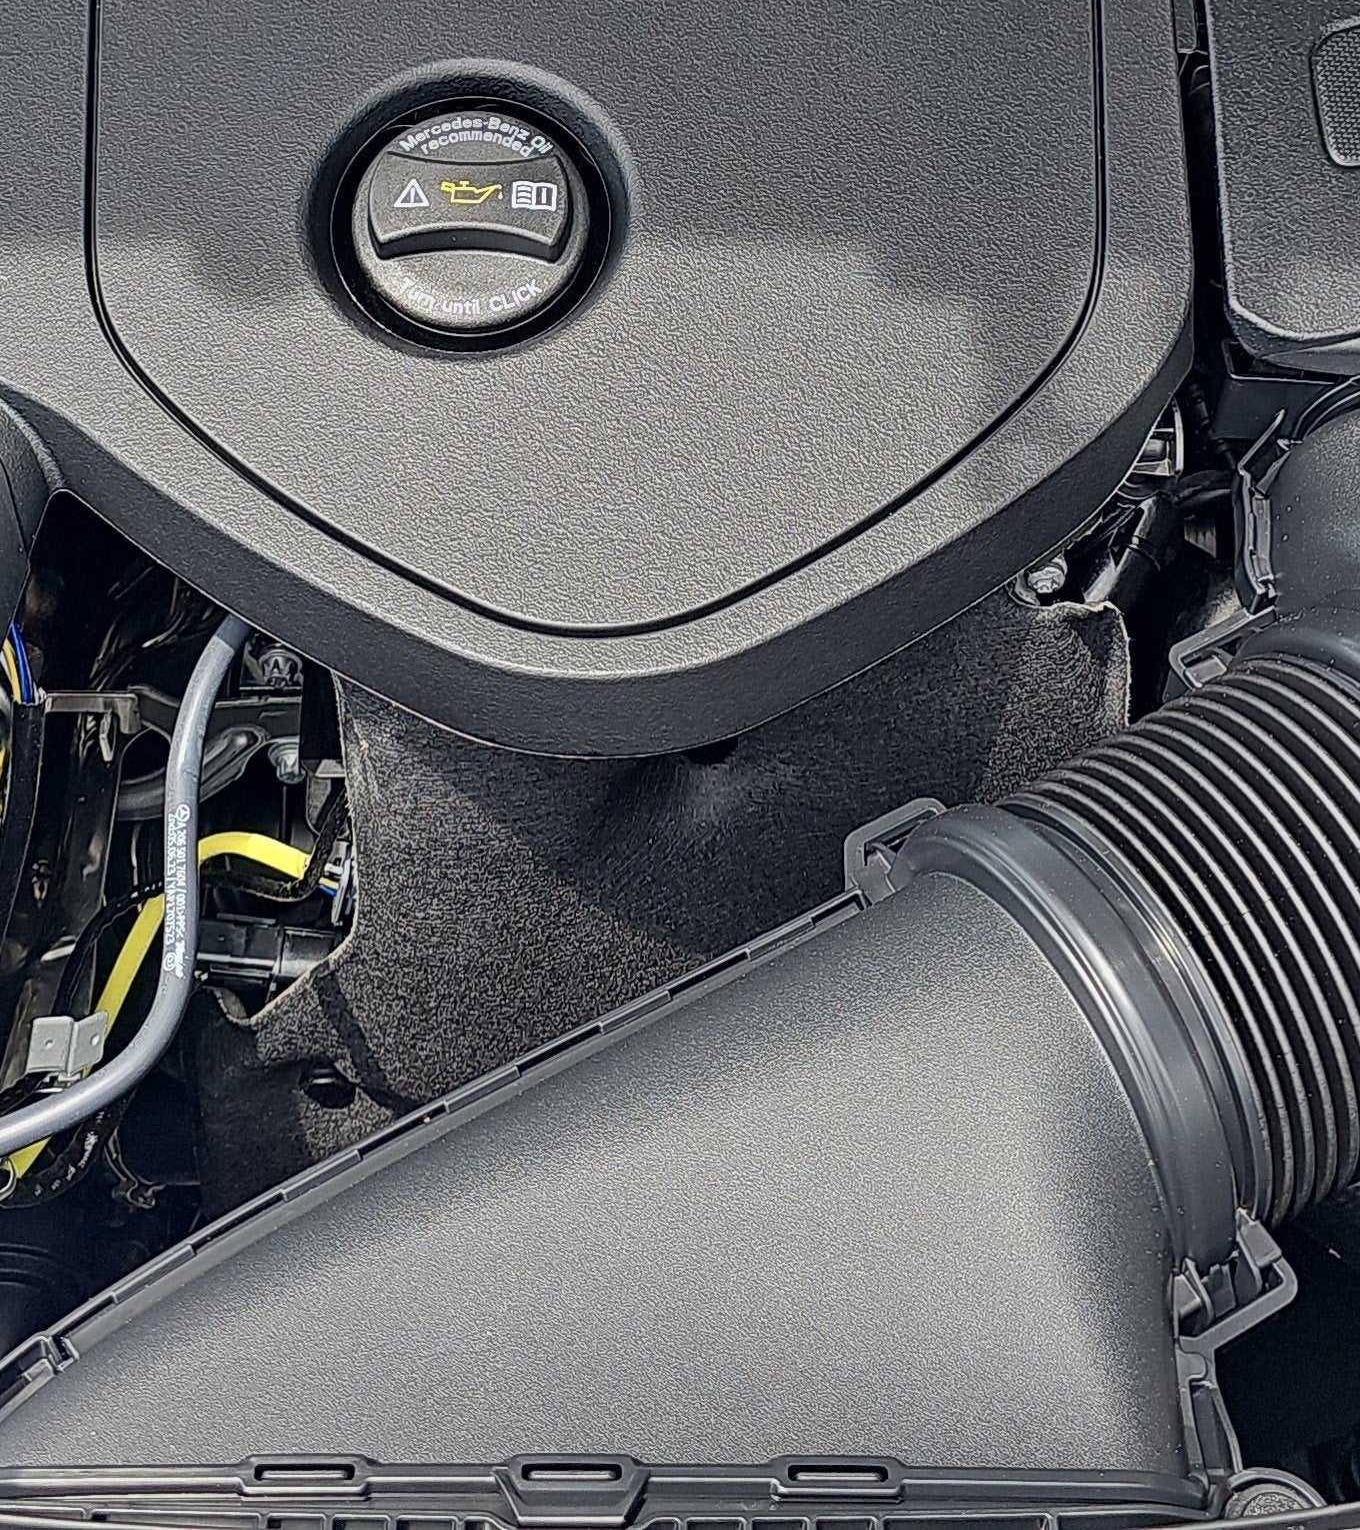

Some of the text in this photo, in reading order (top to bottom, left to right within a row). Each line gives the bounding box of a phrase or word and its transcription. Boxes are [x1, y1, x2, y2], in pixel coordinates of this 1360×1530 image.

[399, 116, 554, 154] Mercedes-Benz Oil
[420, 131, 536, 158] recommended
[402, 278, 544, 315] Turn until CLICK
